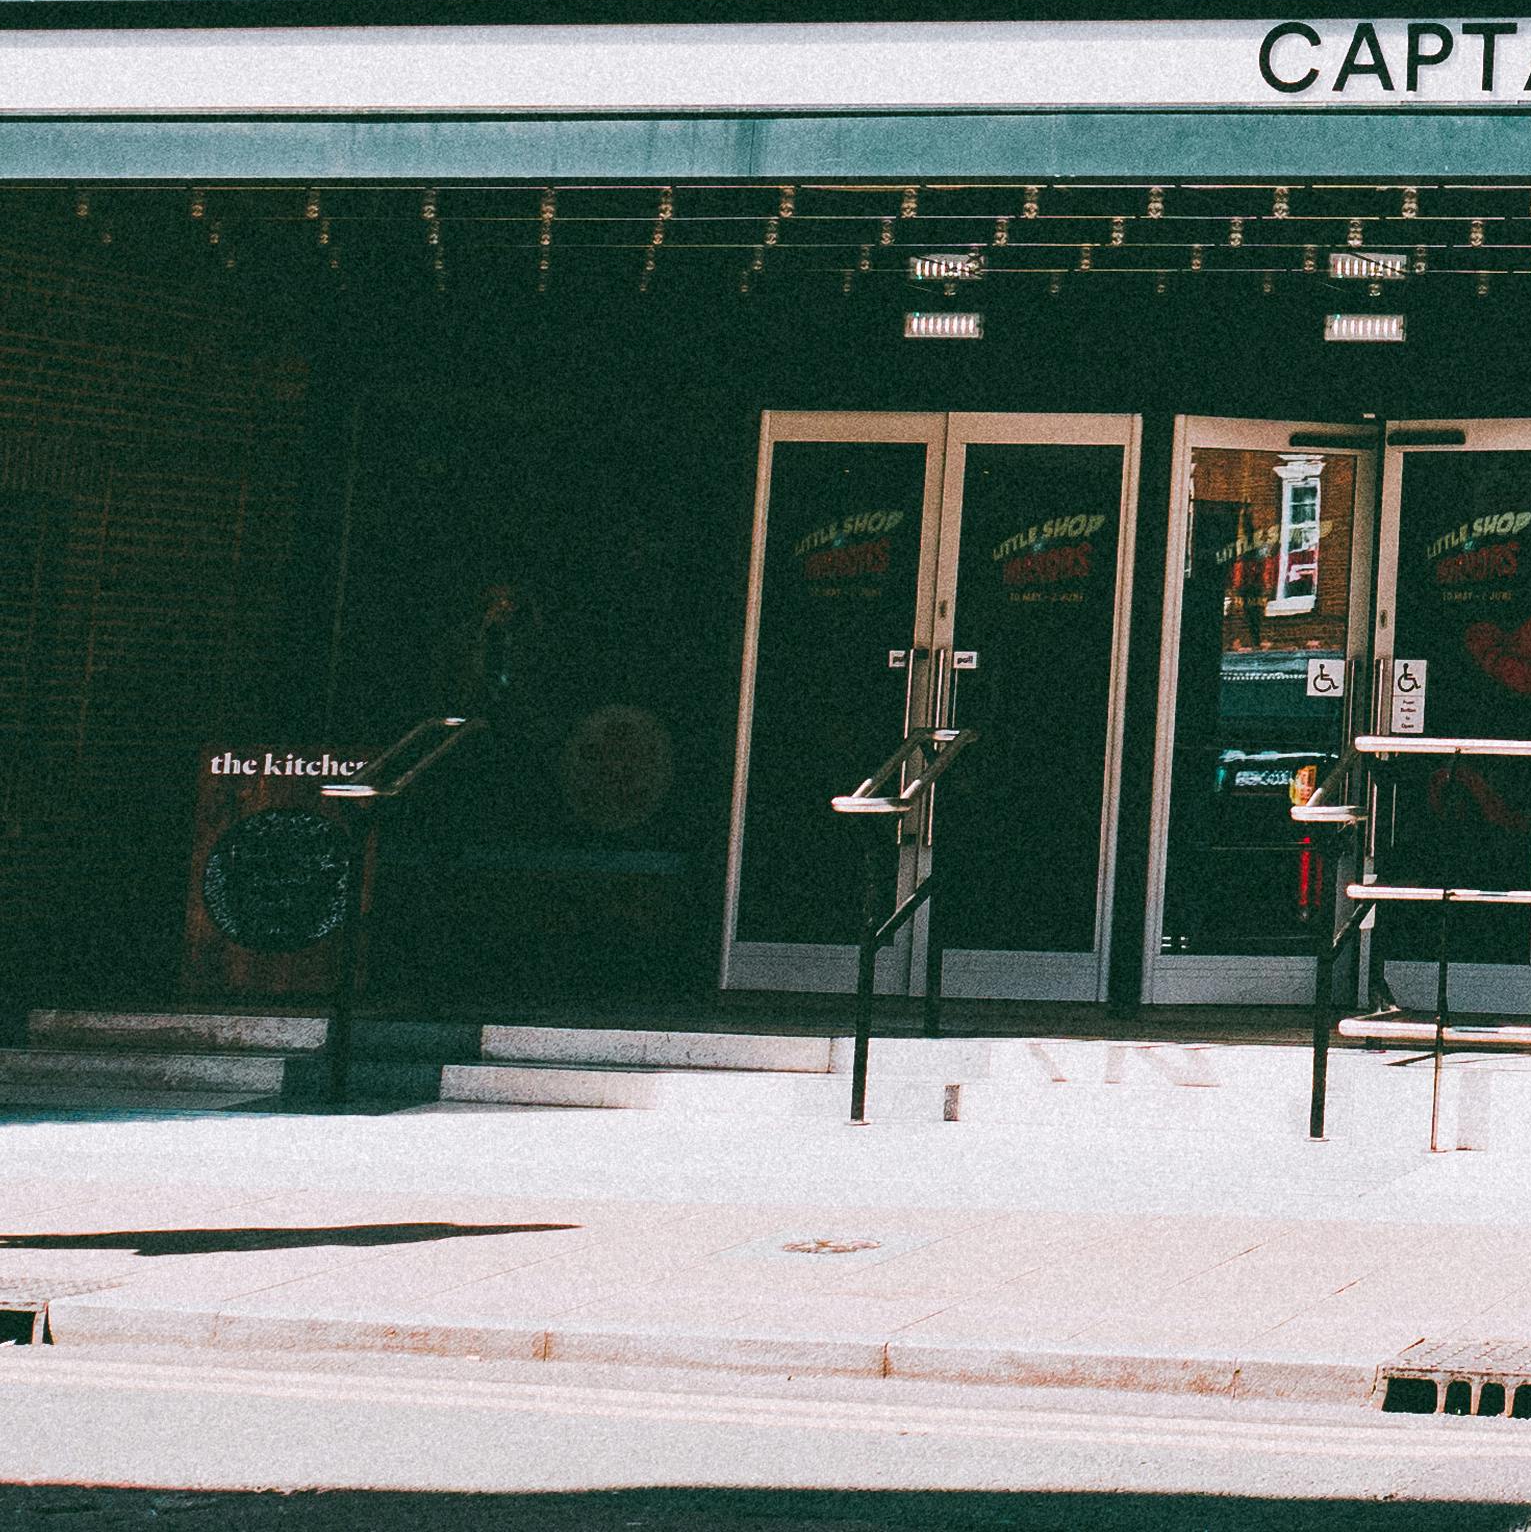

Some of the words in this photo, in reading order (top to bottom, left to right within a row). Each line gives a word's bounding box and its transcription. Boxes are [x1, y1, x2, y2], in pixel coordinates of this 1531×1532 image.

[843, 510, 905, 535] SHOP
[992, 526, 1037, 560] LITTLE
[1042, 514, 1106, 538] SHOP
[1426, 523, 1468, 559] LITTLE
[1472, 511, 1531, 538] SHOP
[210, 752, 257, 775] the
